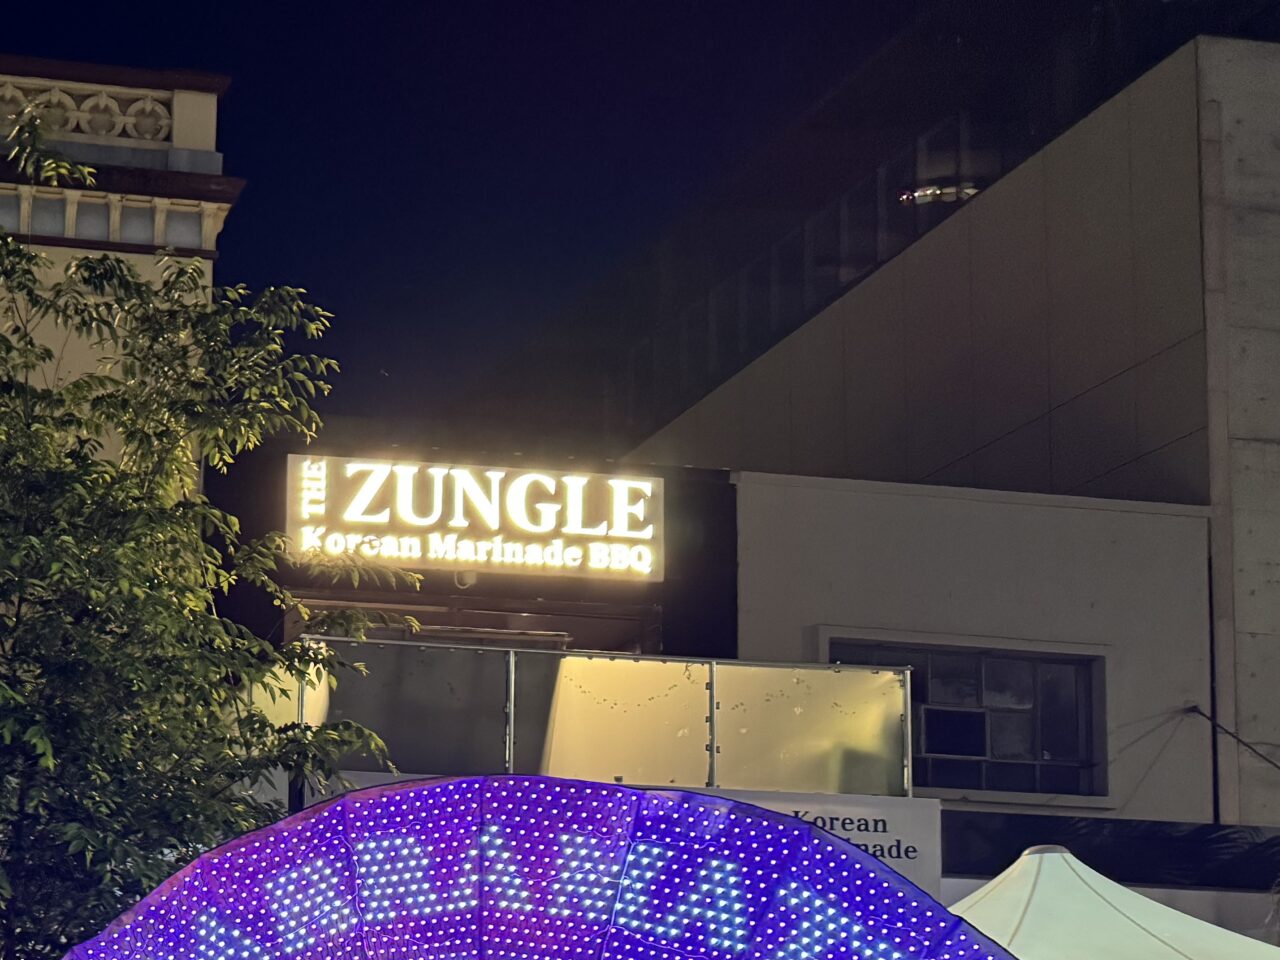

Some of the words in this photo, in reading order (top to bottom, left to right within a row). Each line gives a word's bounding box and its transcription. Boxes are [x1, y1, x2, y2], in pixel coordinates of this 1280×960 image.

[301, 460, 326, 520] THE
[342, 463, 654, 540] ZUNGLE
[301, 526, 421, 559] Korean
[427, 533, 583, 567] Marinade
[588, 542, 652, 574] BBQ
